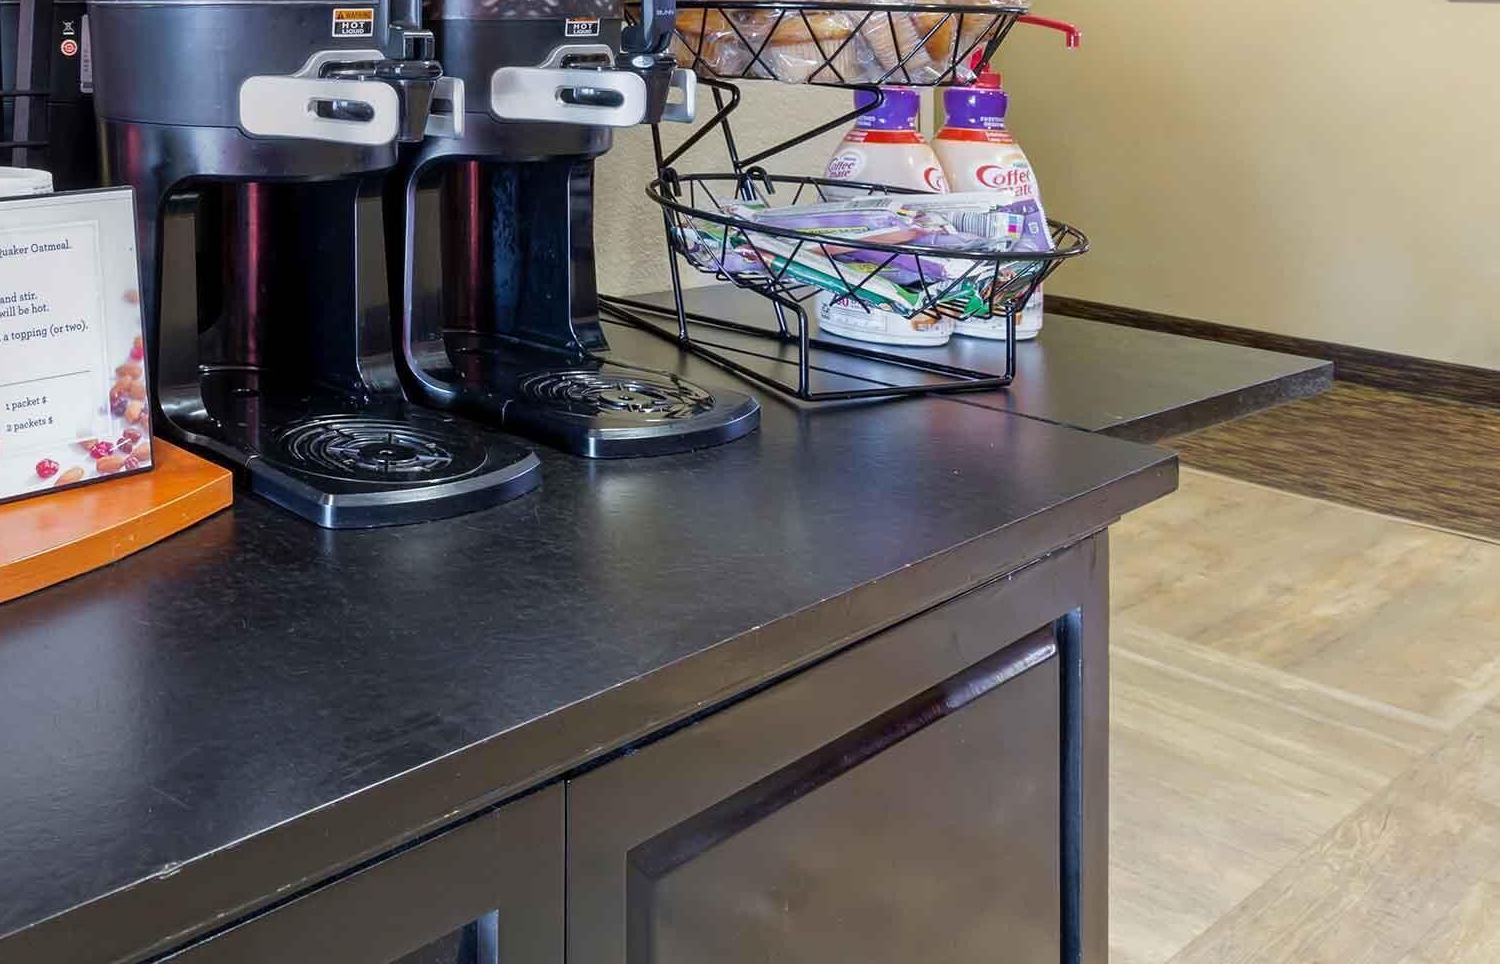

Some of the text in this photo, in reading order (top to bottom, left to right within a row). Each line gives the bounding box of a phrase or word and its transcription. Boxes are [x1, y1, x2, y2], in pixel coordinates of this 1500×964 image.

[0, 293, 17, 304] and
[19, 291, 38, 301] stir.
[0, 305, 16, 318] will
[18, 303, 30, 315] be
[31, 302, 49, 313] hot.
[11, 327, 48, 342] topping
[50, 323, 65, 336] (or
[65, 320, 89, 333] two).
[11, 396, 41, 411] packet
[14, 417, 47, 432] packets
